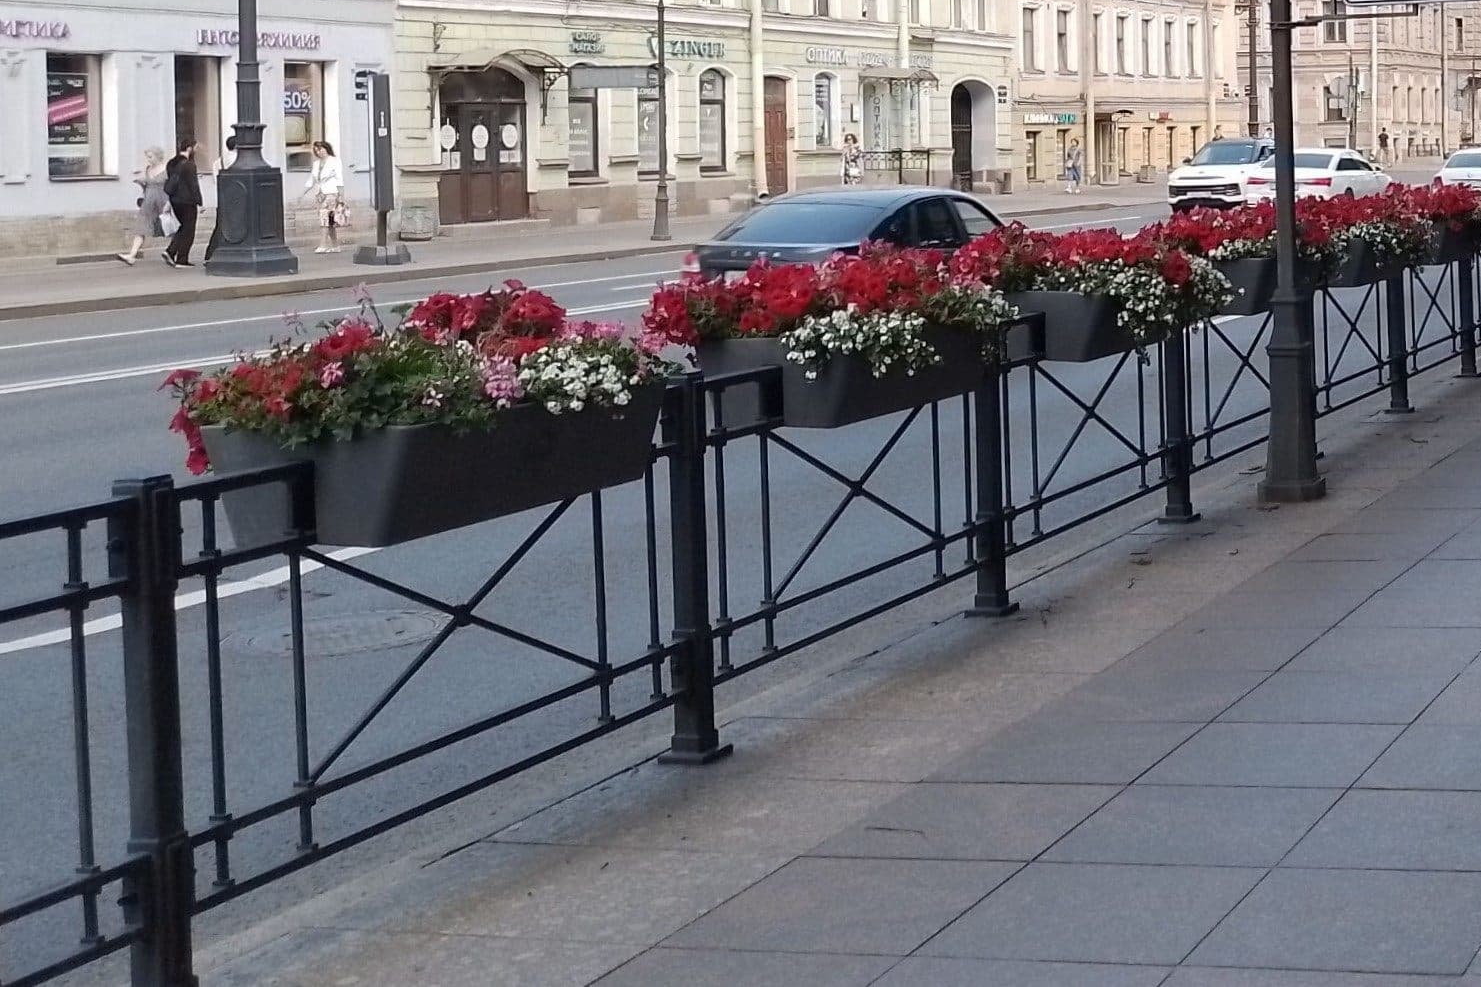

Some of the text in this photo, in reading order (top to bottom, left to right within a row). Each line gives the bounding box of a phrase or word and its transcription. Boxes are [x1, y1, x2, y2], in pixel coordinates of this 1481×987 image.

[197, 28, 268, 48] БЫТОЯ
[670, 40, 726, 58] ZINGER
[806, 46, 847, 64] ОПТИКА
